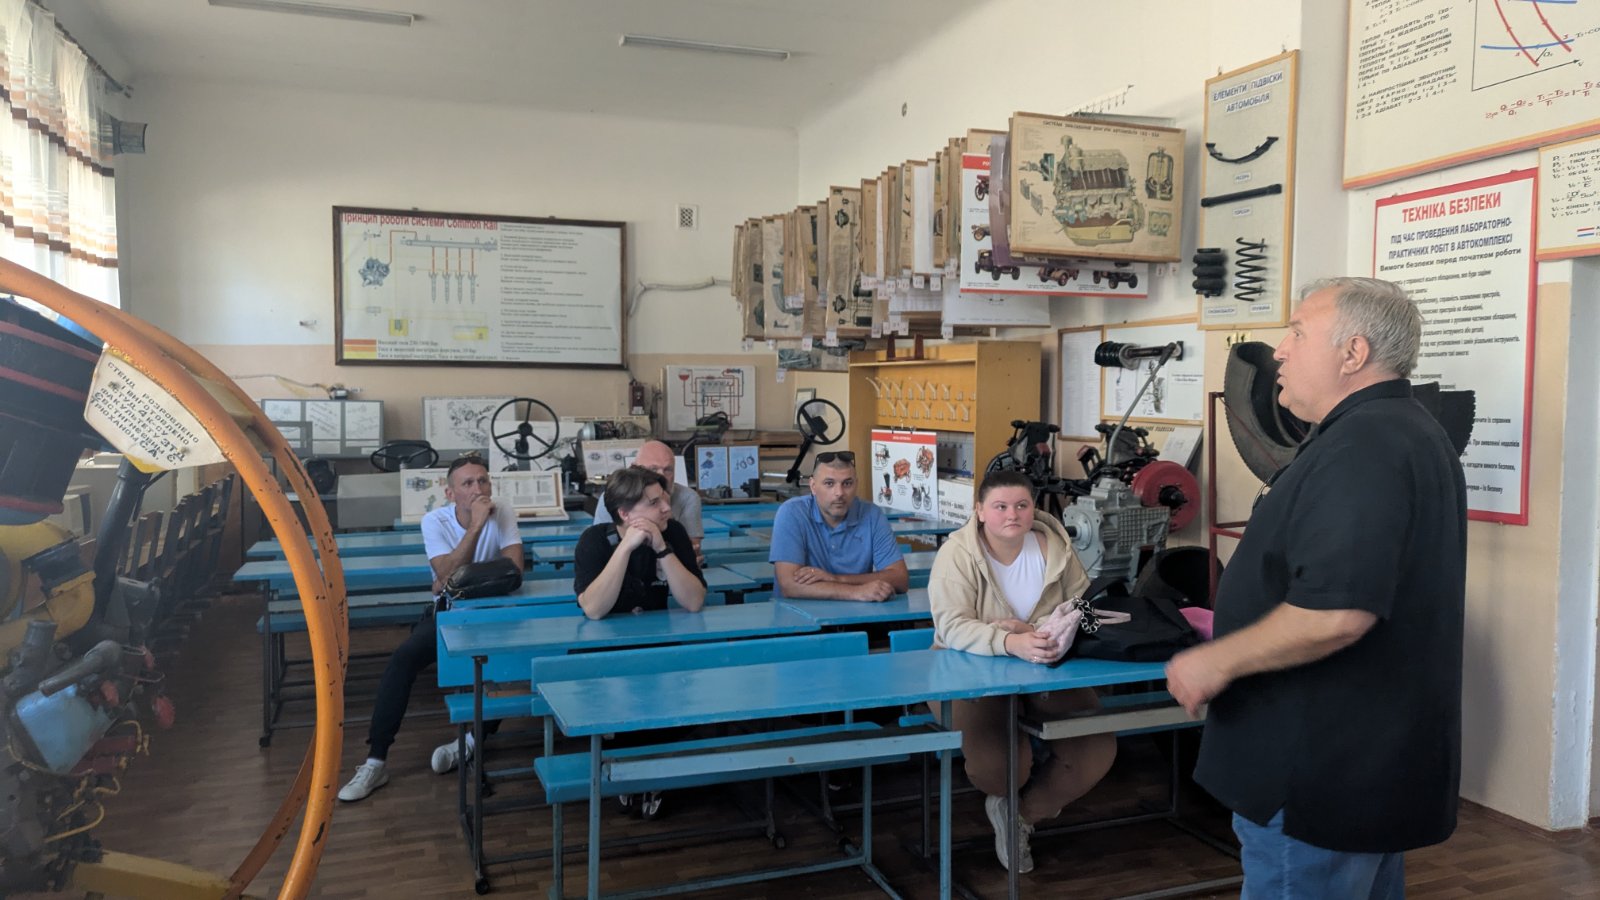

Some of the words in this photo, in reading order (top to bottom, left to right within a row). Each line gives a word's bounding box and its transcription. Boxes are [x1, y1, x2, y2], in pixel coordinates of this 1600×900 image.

[1214, 84, 1248, 101] ЕЛЕМЕНТИ
[1250, 72, 1283, 89] ПІДВІСКИ
[1226, 92, 1270, 112] АВТОМОБІЛЯ
[1402, 200, 1446, 223] ТЕХНІКА
[1450, 191, 1502, 215] БЕЗПЕКИ
[380, 216, 409, 226] роботи
[412, 218, 445, 228] системи
[448, 218, 482, 230] Common
[1391, 234, 1402, 244] ПІД
[1403, 230, 1416, 241] ЧАС
[1417, 225, 1458, 240] ПРОВЕДЕННЯ
[1460, 217, 1512, 233] ЛАБОРАТОРНО-
[1380, 262, 1404, 272] Вимоги
[1406, 258, 1434, 268] безпеки
[1436, 256, 1458, 266] перед
[1459, 252, 1494, 262] початком
[1495, 248, 1522, 258] роботи
[1388, 246, 1428, 260] ПРАКТИЧНИХ
[1430, 242, 1449, 256] РОБІТ
[1451, 242, 1456, 250] В
[1456, 234, 1512, 250] АВТОКОМПЛЕКСІ
[100, 387, 160, 439] ФАКУЛЬТЕТУ
[108, 362, 136, 389] СТЕНД
[142, 392, 200, 444] РОЗРОБЛЕНО
[138, 409, 148, 418] 4
[126, 390, 190, 446] ВИГОТОВЛЕНО
